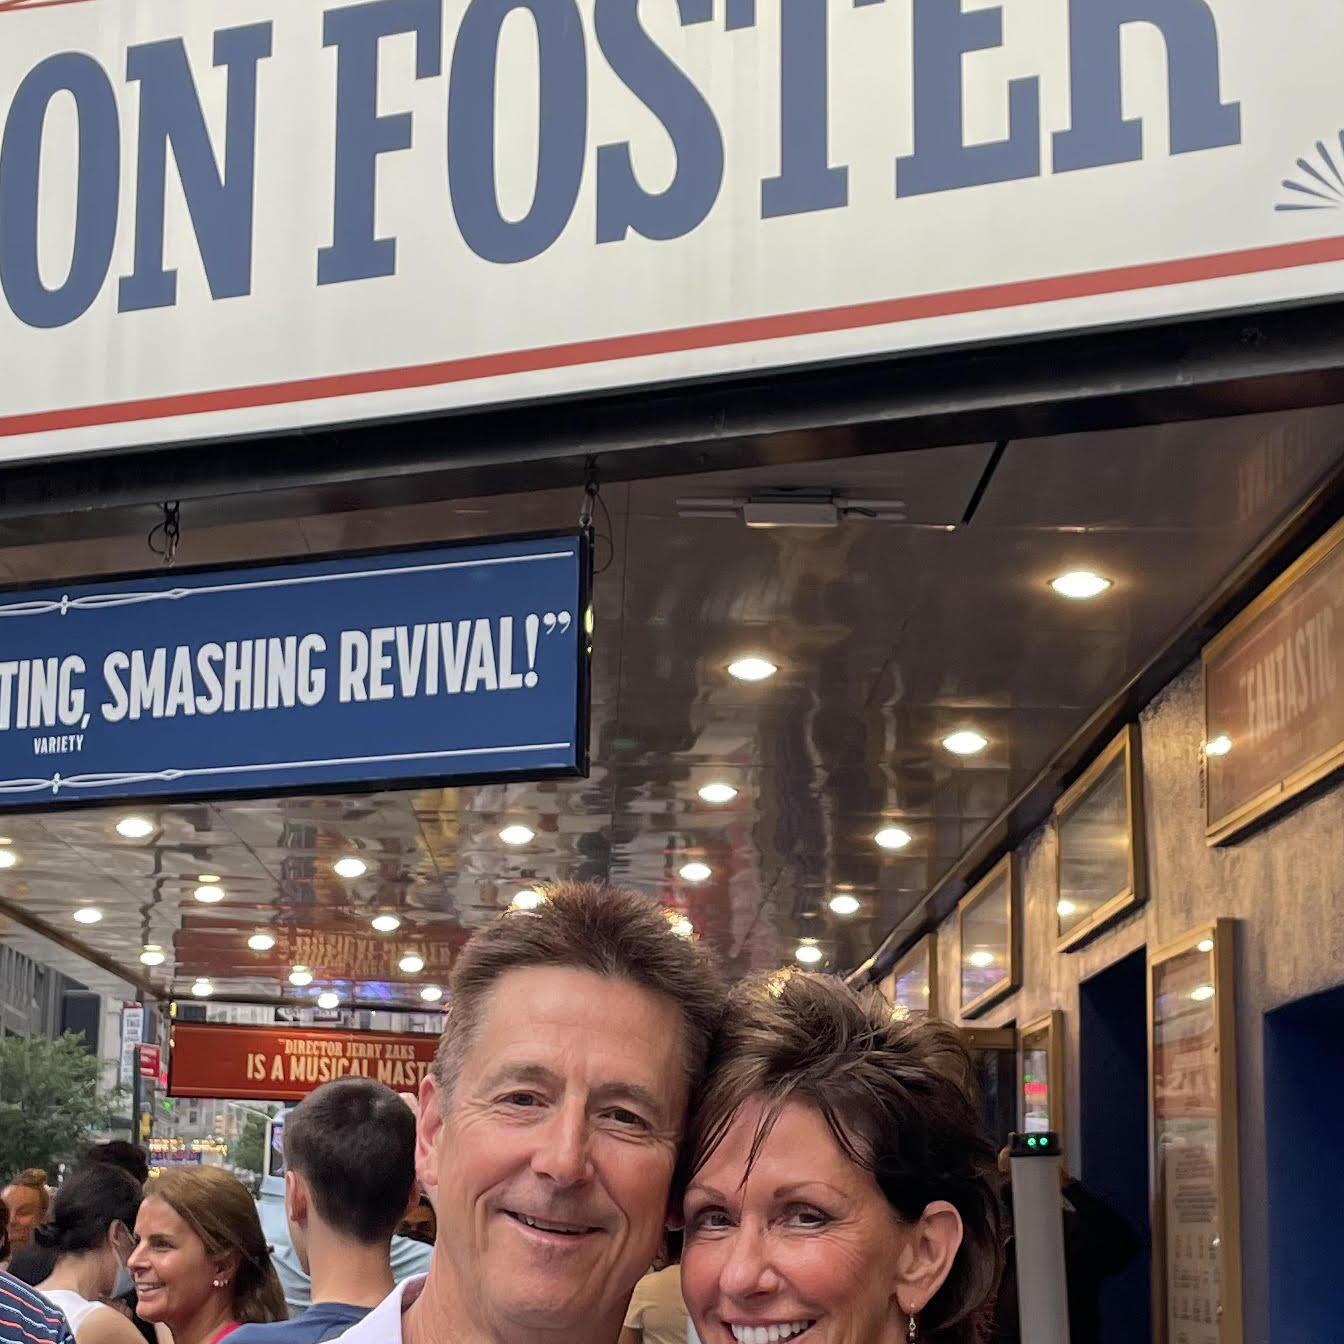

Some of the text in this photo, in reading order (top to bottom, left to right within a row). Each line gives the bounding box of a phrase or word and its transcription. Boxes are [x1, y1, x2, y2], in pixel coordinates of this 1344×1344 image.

[101, 632, 327, 724] SMASHING
[338, 610, 572, 704] REVIVAL!”
[32, 733, 85, 756] VARIETY
[345, 1042, 383, 1059] JERRY
[385, 1044, 416, 1060] ZAKS
[246, 1053, 267, 1081] IS
[271, 1054, 285, 1082] A
[377, 1060, 434, 1088] MAST
